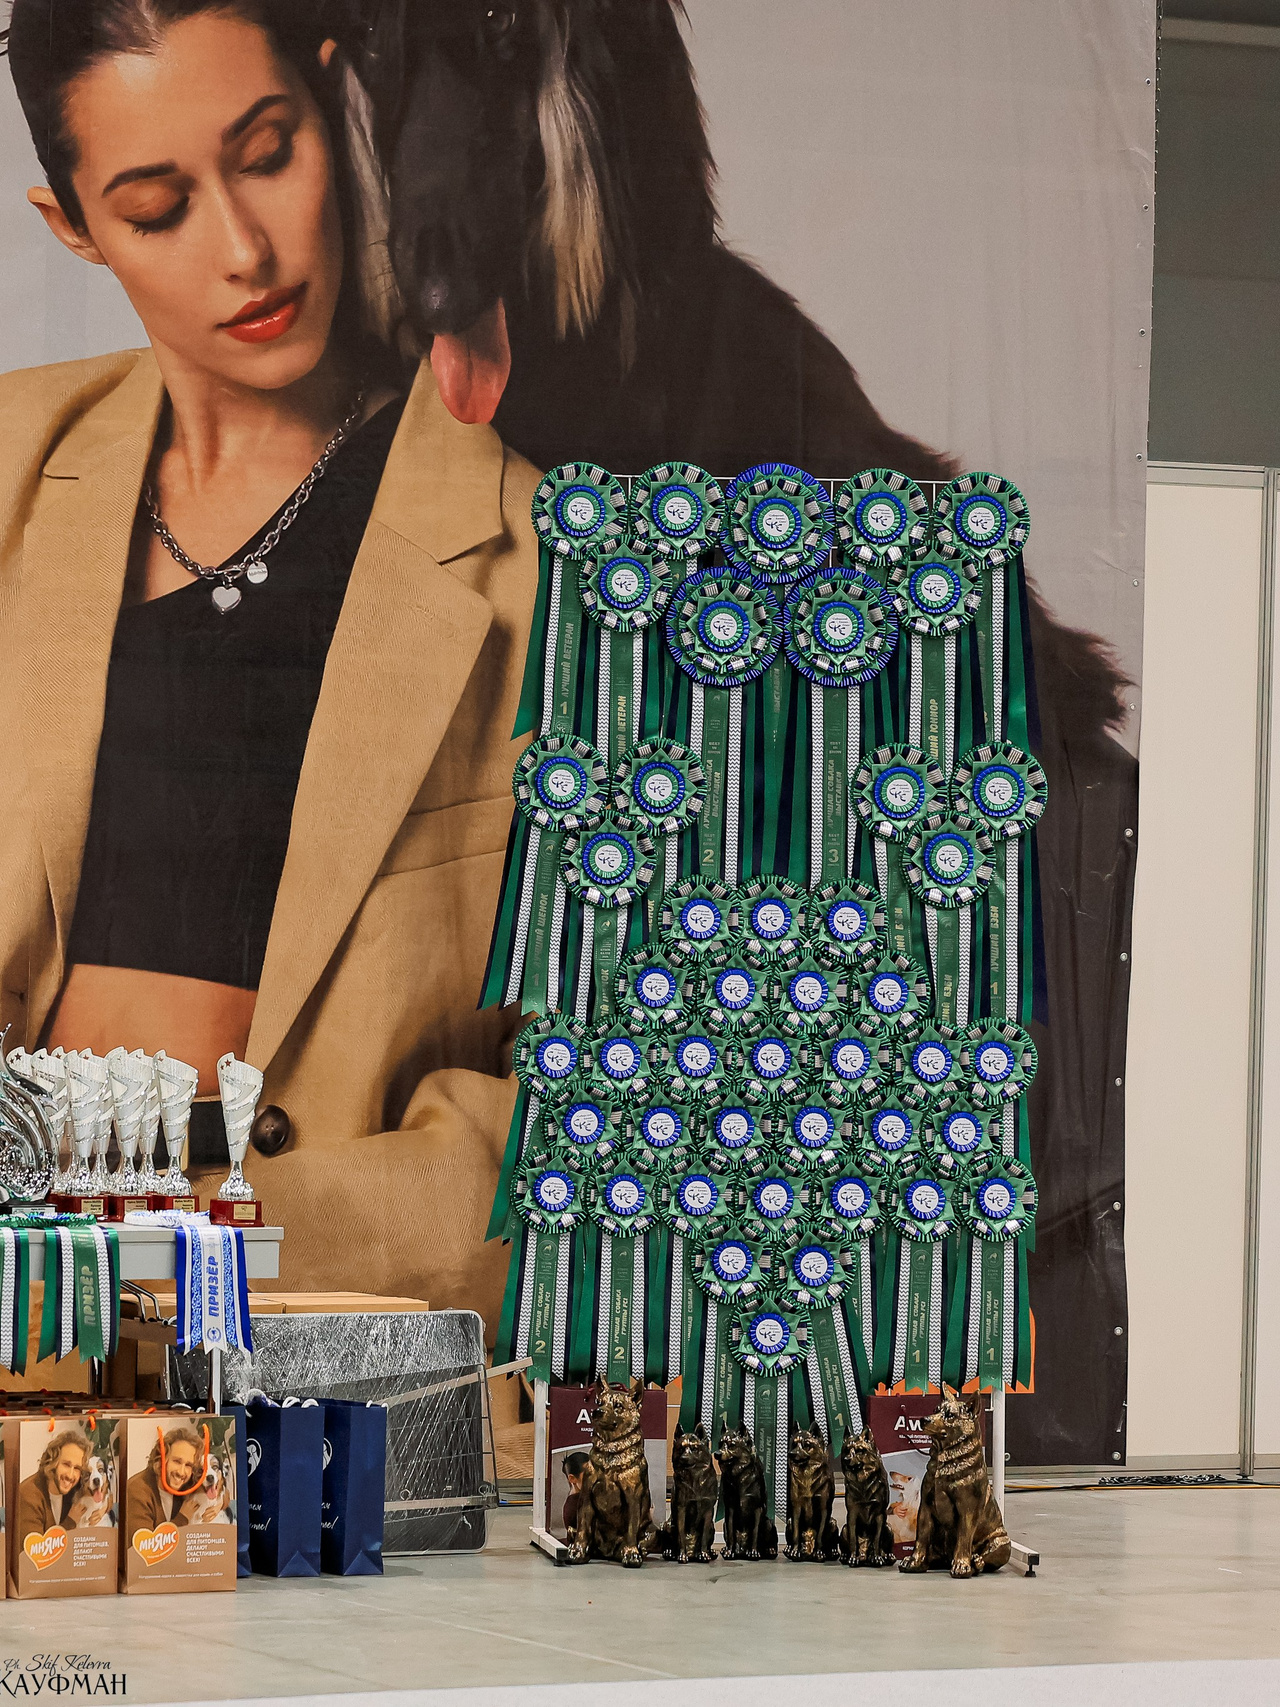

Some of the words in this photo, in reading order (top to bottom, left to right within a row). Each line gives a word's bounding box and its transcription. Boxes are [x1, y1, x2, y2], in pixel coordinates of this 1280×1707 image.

[563, 622, 574, 660] ВЕТЕРАН
[561, 662, 570, 698] ЛУЧШИЙ
[559, 701, 568, 715] 1
[617, 695, 627, 732] ВЕТЕРАН
[930, 699, 939, 733] ЮНИОР
[703, 849, 714, 863] 2
[828, 849, 839, 863] 3
[537, 893, 549, 927] ЩЕНОК
[990, 906, 999, 929] БЭБИ
[990, 934, 999, 973] ЛУЧШИЙ
[944, 975, 953, 998] БЭБИ
[990, 982, 998, 995] 1
[204, 1255, 220, 1318] ПРИЗЁР
[537, 1283, 545, 1307] СОБАКА
[535, 1340, 546, 1354] 2
[614, 1346, 625, 1360] 2
[912, 1349, 920, 1362] 1
[986, 1347, 995, 1361] 1
[834, 1412, 844, 1427] 1
[30, 1534, 65, 1557] МНЯМС
[139, 1530, 177, 1552] МНЯМС
